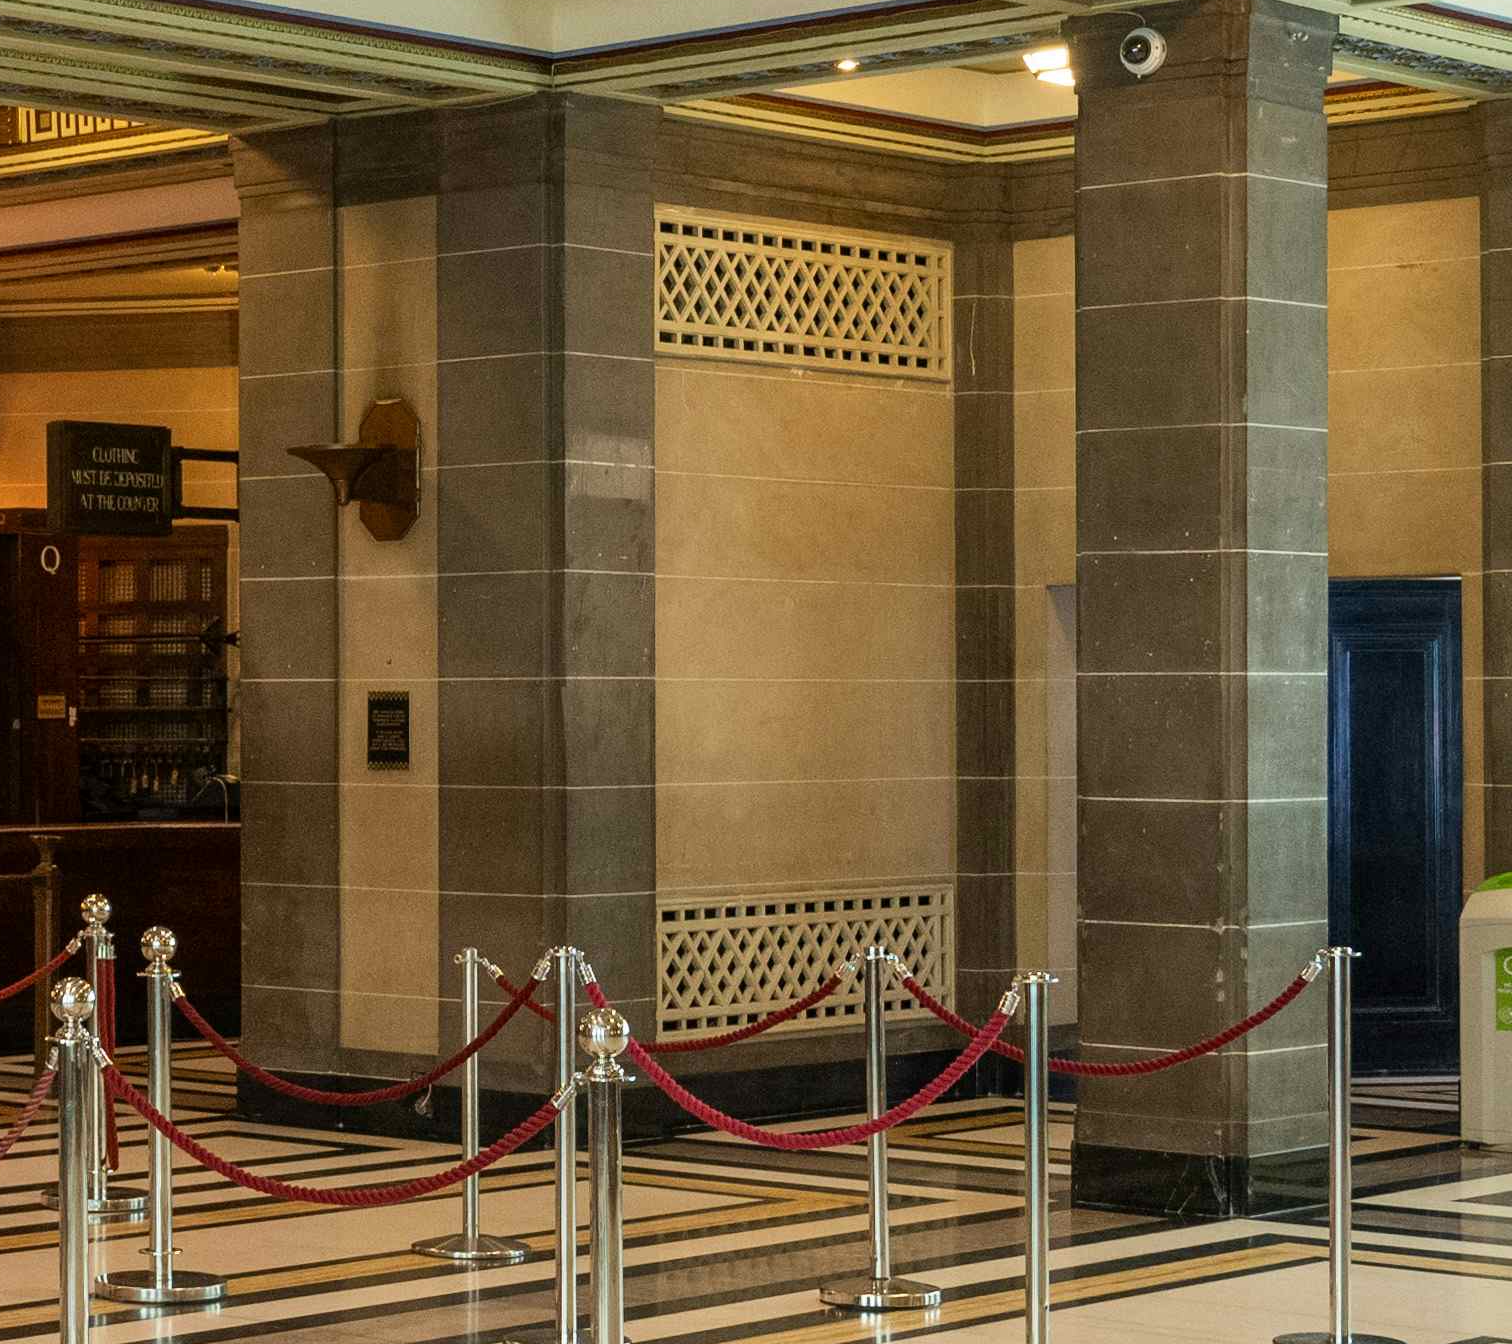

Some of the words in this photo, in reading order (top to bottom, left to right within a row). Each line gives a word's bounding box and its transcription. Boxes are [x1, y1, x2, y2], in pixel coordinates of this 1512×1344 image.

[71, 469, 96, 485] MUST
[79, 493, 93, 511] AT
[96, 494, 115, 511] THE
[40, 545, 60, 575] Q
